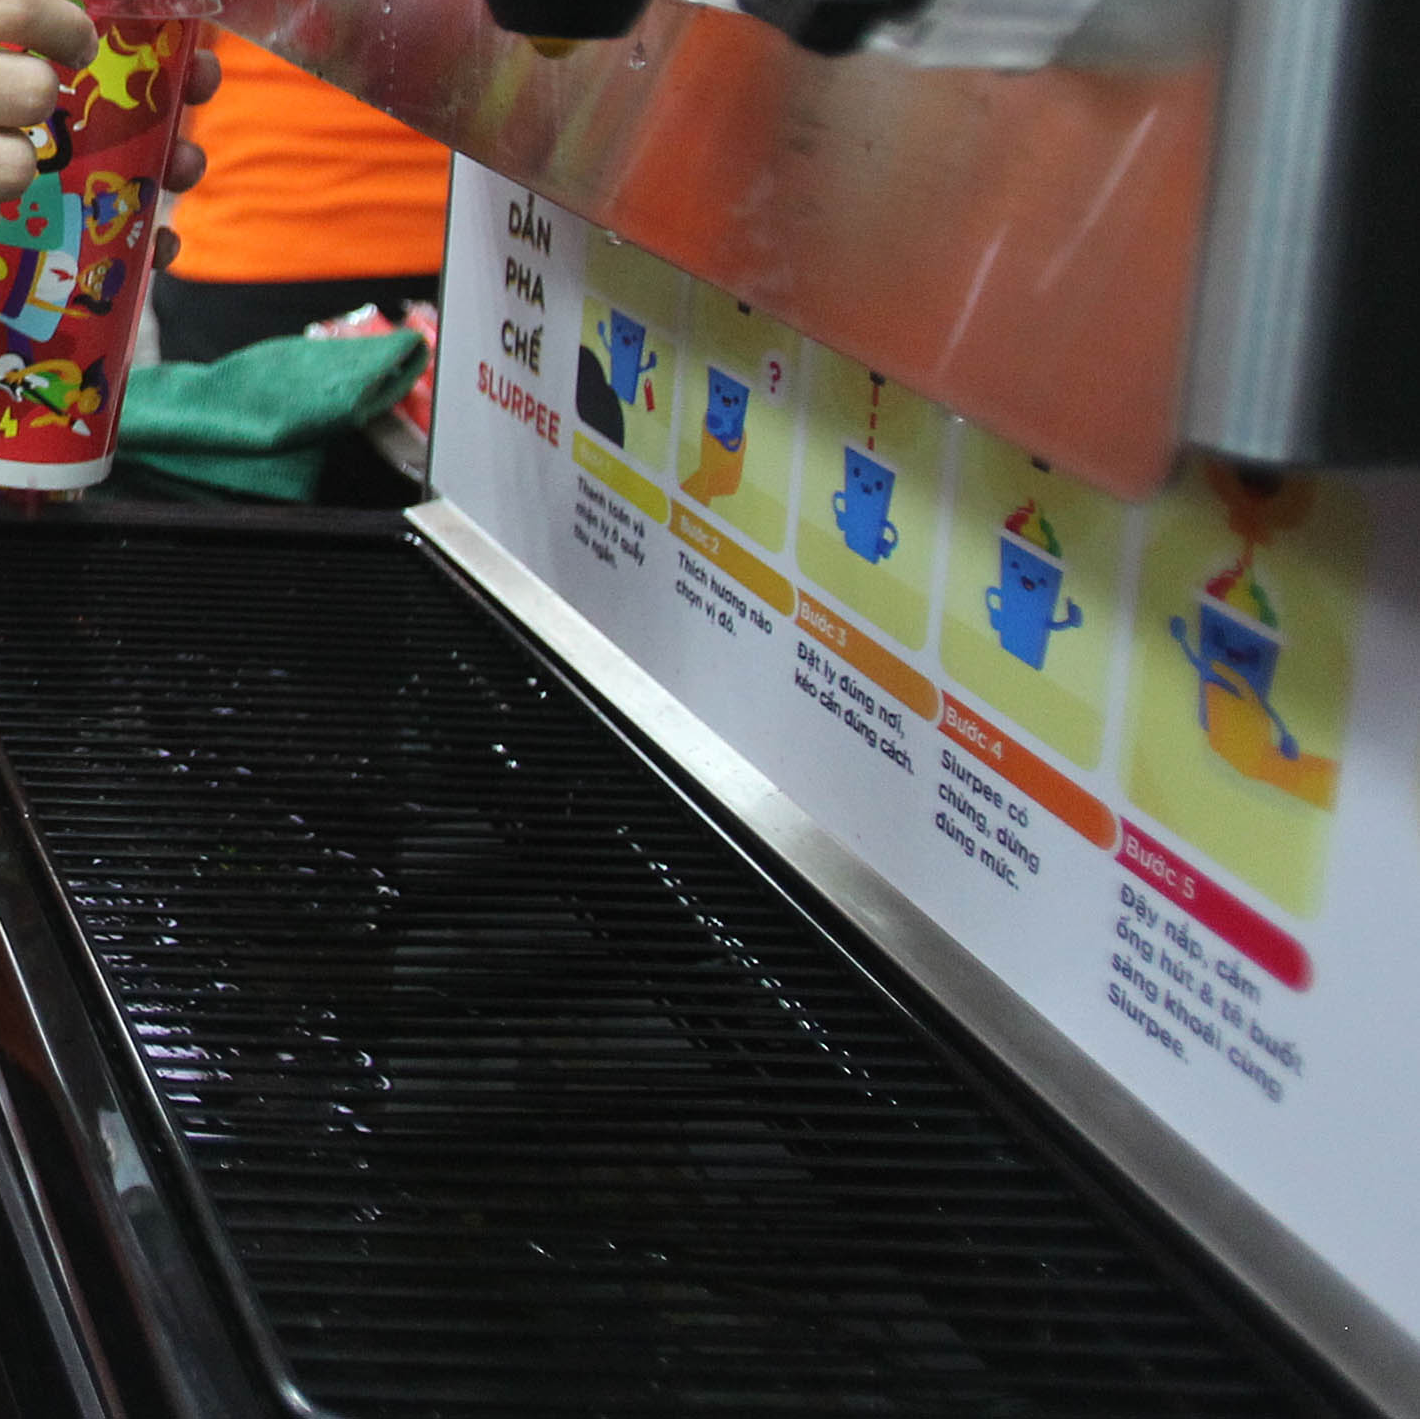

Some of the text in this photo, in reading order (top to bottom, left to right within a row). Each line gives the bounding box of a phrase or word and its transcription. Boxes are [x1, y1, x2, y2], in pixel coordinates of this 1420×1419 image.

[505, 256, 545, 312] PHA
[501, 318, 543, 375] CHẾ
[476, 360, 560, 448] SLURPEE
[675, 579, 703, 610] chọn
[836, 627, 848, 648] 3
[794, 667, 818, 699] kéo
[844, 708, 878, 748] đúng
[796, 641, 820, 674] Đặt
[823, 659, 837, 686] ly
[840, 673, 875, 716] đúng
[945, 706, 1005, 761] Bước 4
[940, 748, 1028, 829] Slurpee có
[934, 811, 1019, 891] đúng mức.
[1124, 835, 1196, 901] Bước 5
[1120, 881, 1159, 929] Đậy
[1116, 915, 1154, 964] ống
[1160, 947, 1194, 993] hút
[1199, 981, 1213, 1008] &
[1107, 981, 1190, 1065] Slurpee.
